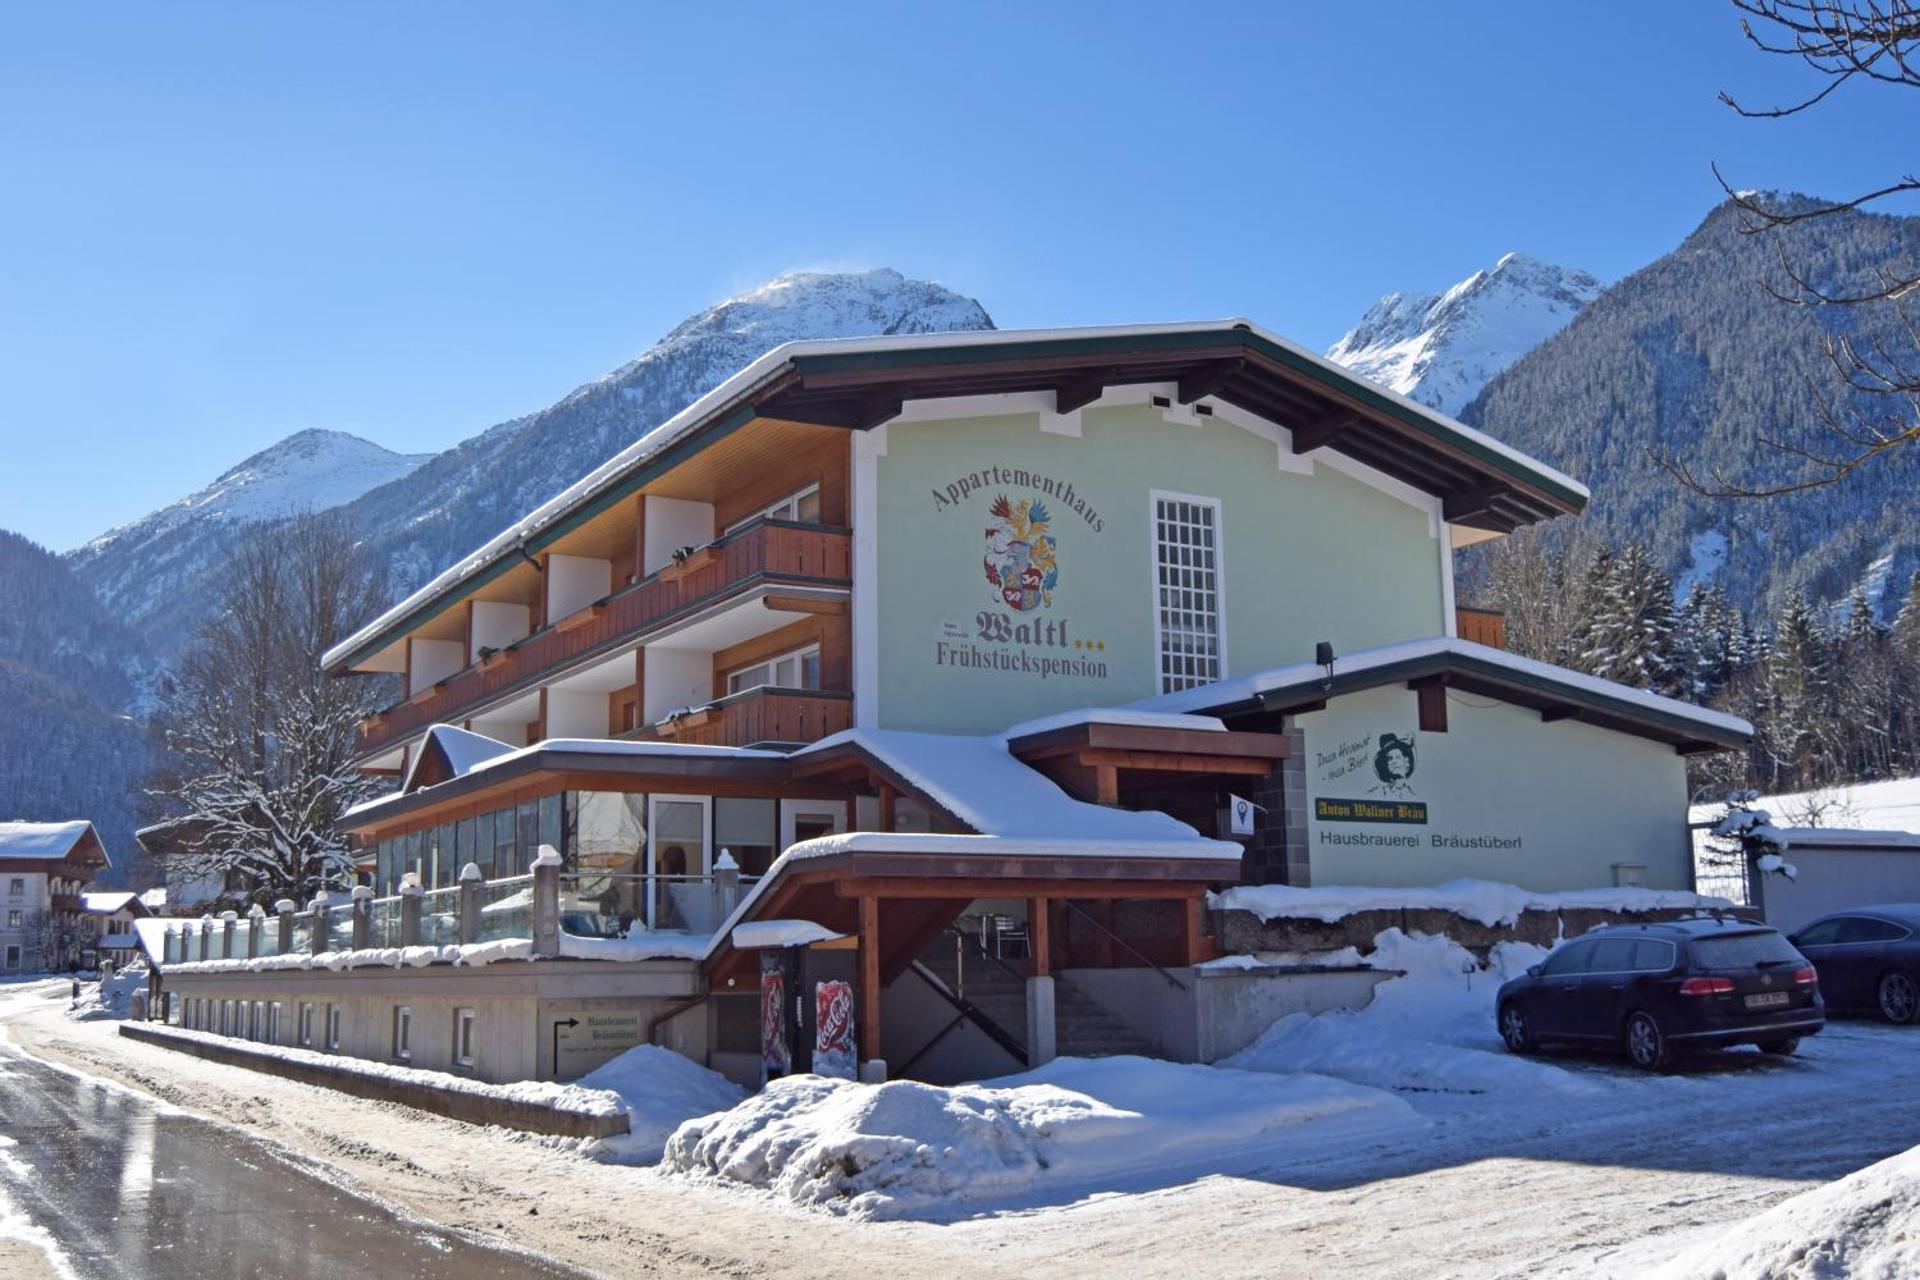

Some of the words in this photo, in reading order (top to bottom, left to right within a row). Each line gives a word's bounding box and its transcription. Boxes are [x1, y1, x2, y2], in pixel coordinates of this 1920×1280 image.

[931, 463, 1105, 534] Appartementhaus
[976, 610, 1069, 648] Waltl
[936, 641, 1107, 678] Frühstückspension
[1320, 831, 1420, 847] Hausbrauerei
[1431, 833, 1522, 849] Bräustüberl
